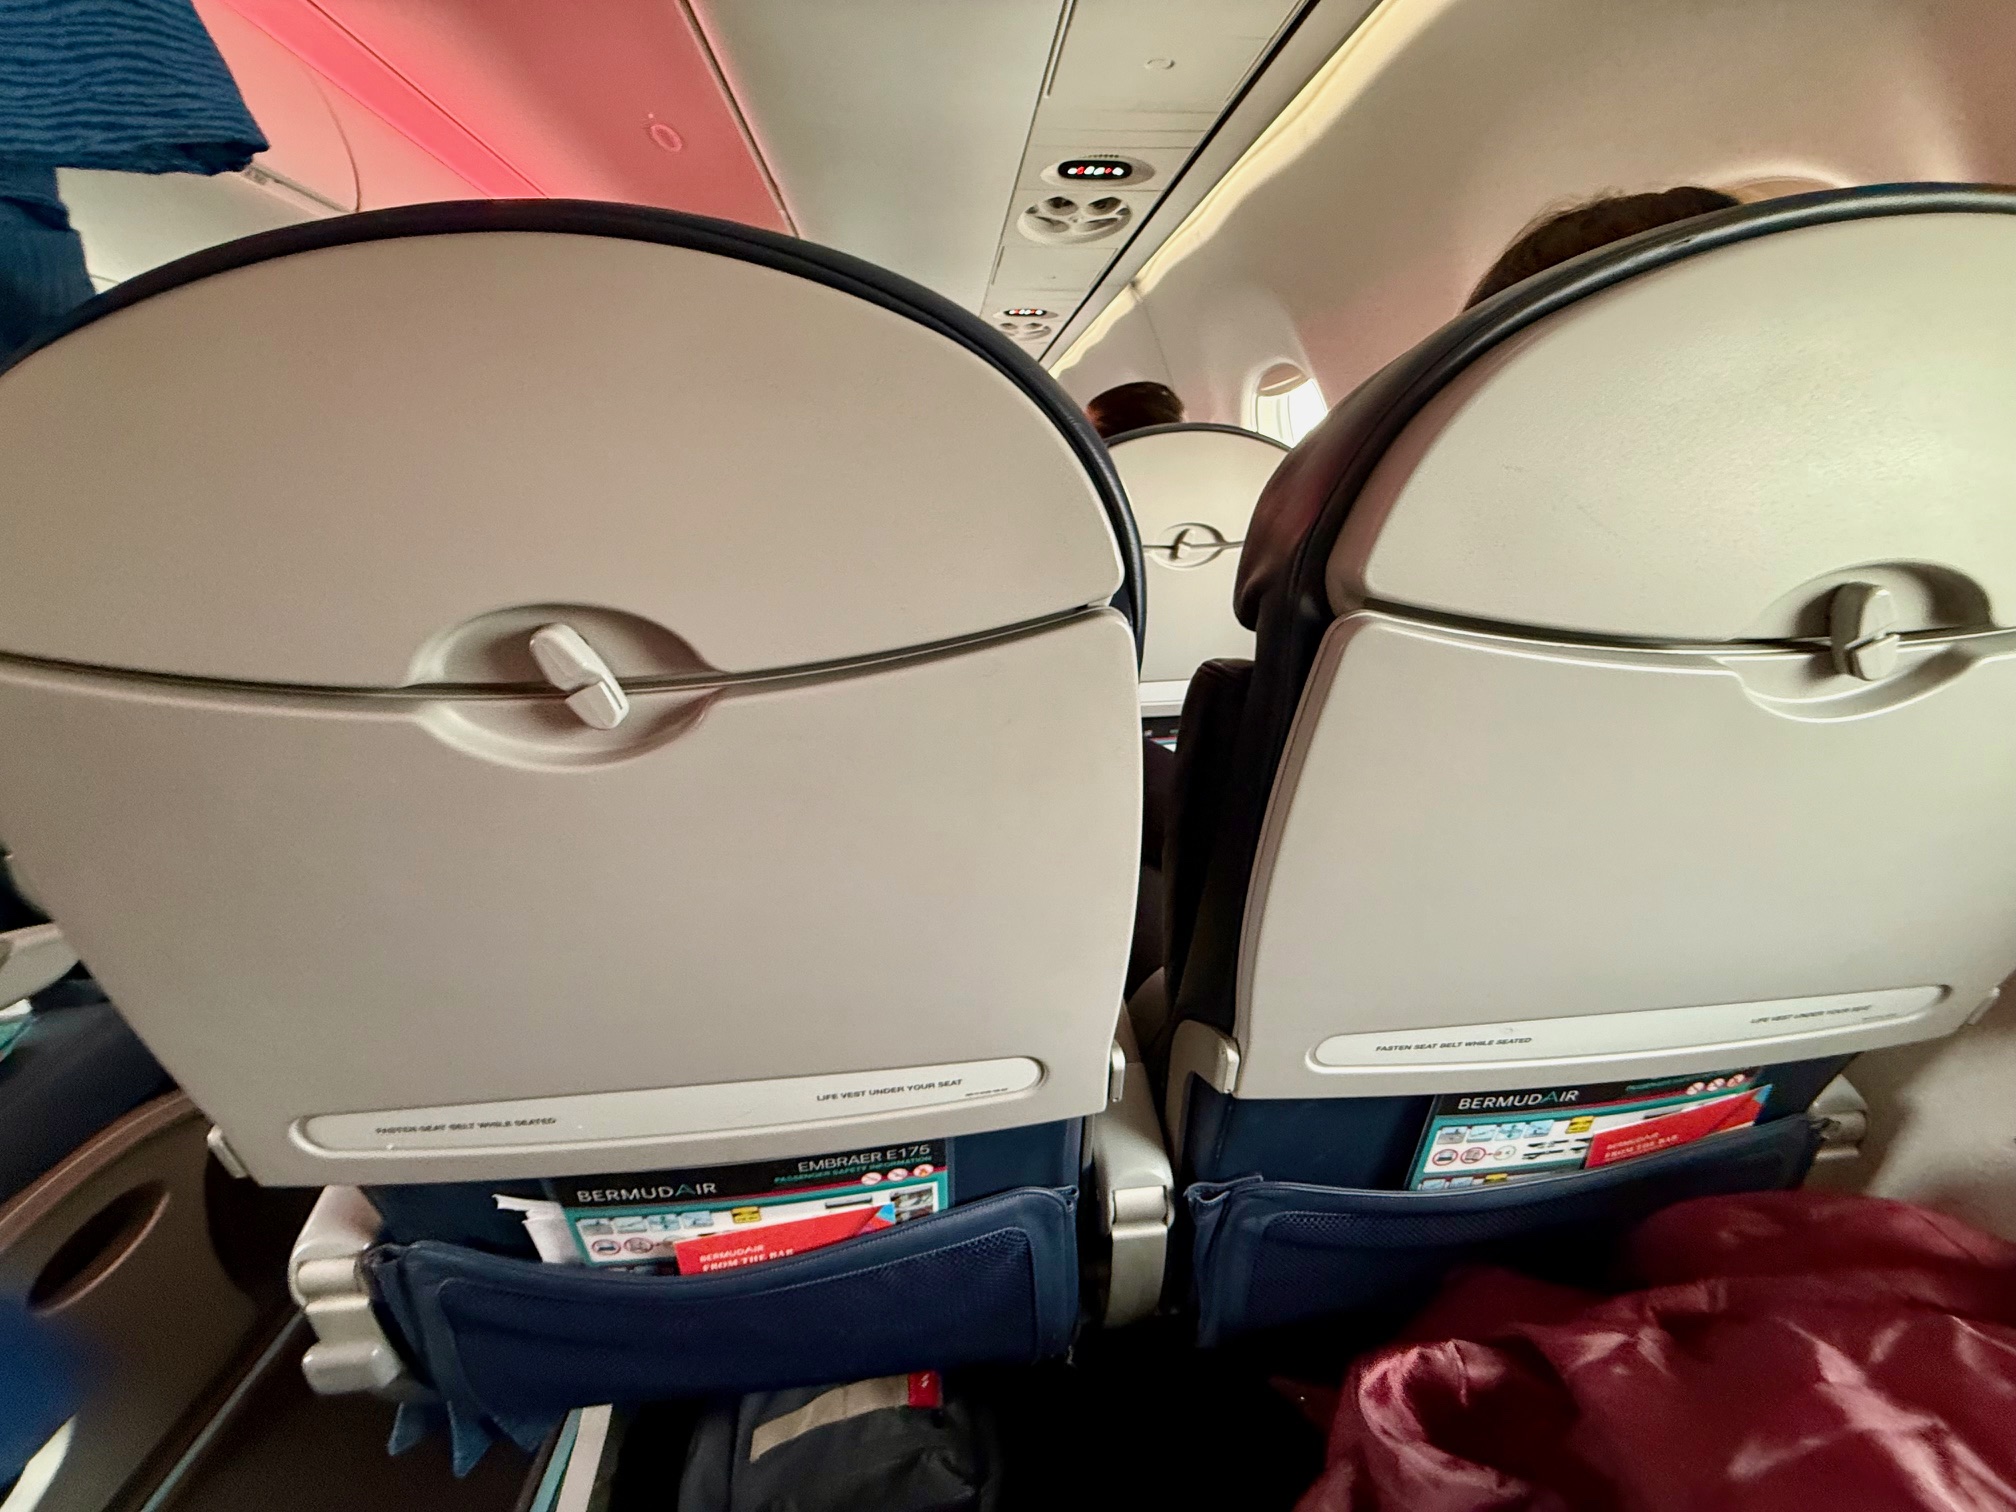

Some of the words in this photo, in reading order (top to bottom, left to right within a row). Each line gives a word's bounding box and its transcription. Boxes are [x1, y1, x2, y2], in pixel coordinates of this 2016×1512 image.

[1414, 1042, 1438, 1050] SEAT
[1439, 1041, 1462, 1049] BELT
[1464, 1039, 1493, 1047] WHILE
[1495, 1037, 1532, 1045] SEATED
[816, 1092, 838, 1101] LIFE
[840, 1090, 866, 1099] VEST
[869, 1086, 905, 1096] UNDER
[907, 1082, 935, 1092] YOUR
[938, 1079, 963, 1088] SEAT
[1457, 1089, 1579, 1110] BERMUDAIR
[797, 1151, 882, 1173] EMBRAER
[886, 1144, 931, 1160] E175
[773, 1170, 831, 1184] PASSENGER
[832, 1164, 867, 1176] SAFETY
[869, 1156, 933, 1171] INFORMATION
[576, 1182, 717, 1203] BERMUDAIR
